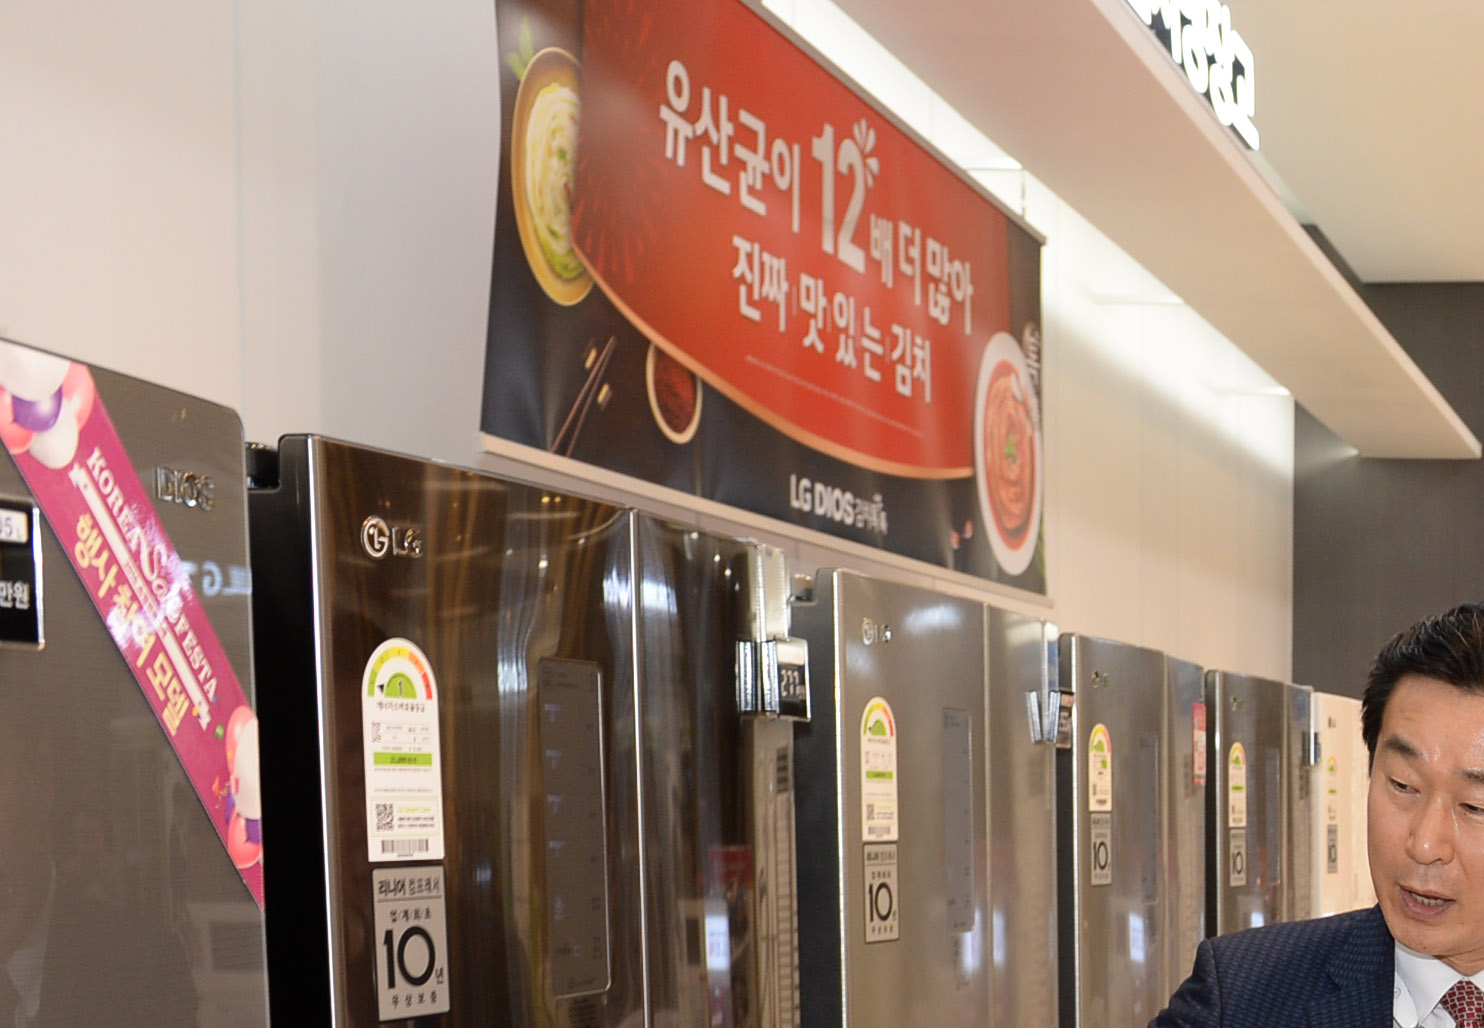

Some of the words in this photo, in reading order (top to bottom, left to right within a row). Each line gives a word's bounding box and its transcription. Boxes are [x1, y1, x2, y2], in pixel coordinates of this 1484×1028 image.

[659, 60, 800, 233] 유산균이
[898, 219, 921, 306] 더
[926, 236, 974, 335] 많아
[732, 235, 788, 332] 진짜
[800, 272, 884, 383] 맛있는
[891, 323, 931, 404] 김치
[790, 474, 813, 512] LG
[814, 481, 855, 526] DIOS
[75, 513, 117, 599] 행사
[146, 652, 189, 736] 모델
[86, 447, 146, 549] KOREA
[172, 613, 218, 702] FESTA
[378, 878, 406, 897] 리니어
[868, 882, 893, 922] 10
[1093, 841, 1109, 870] 10
